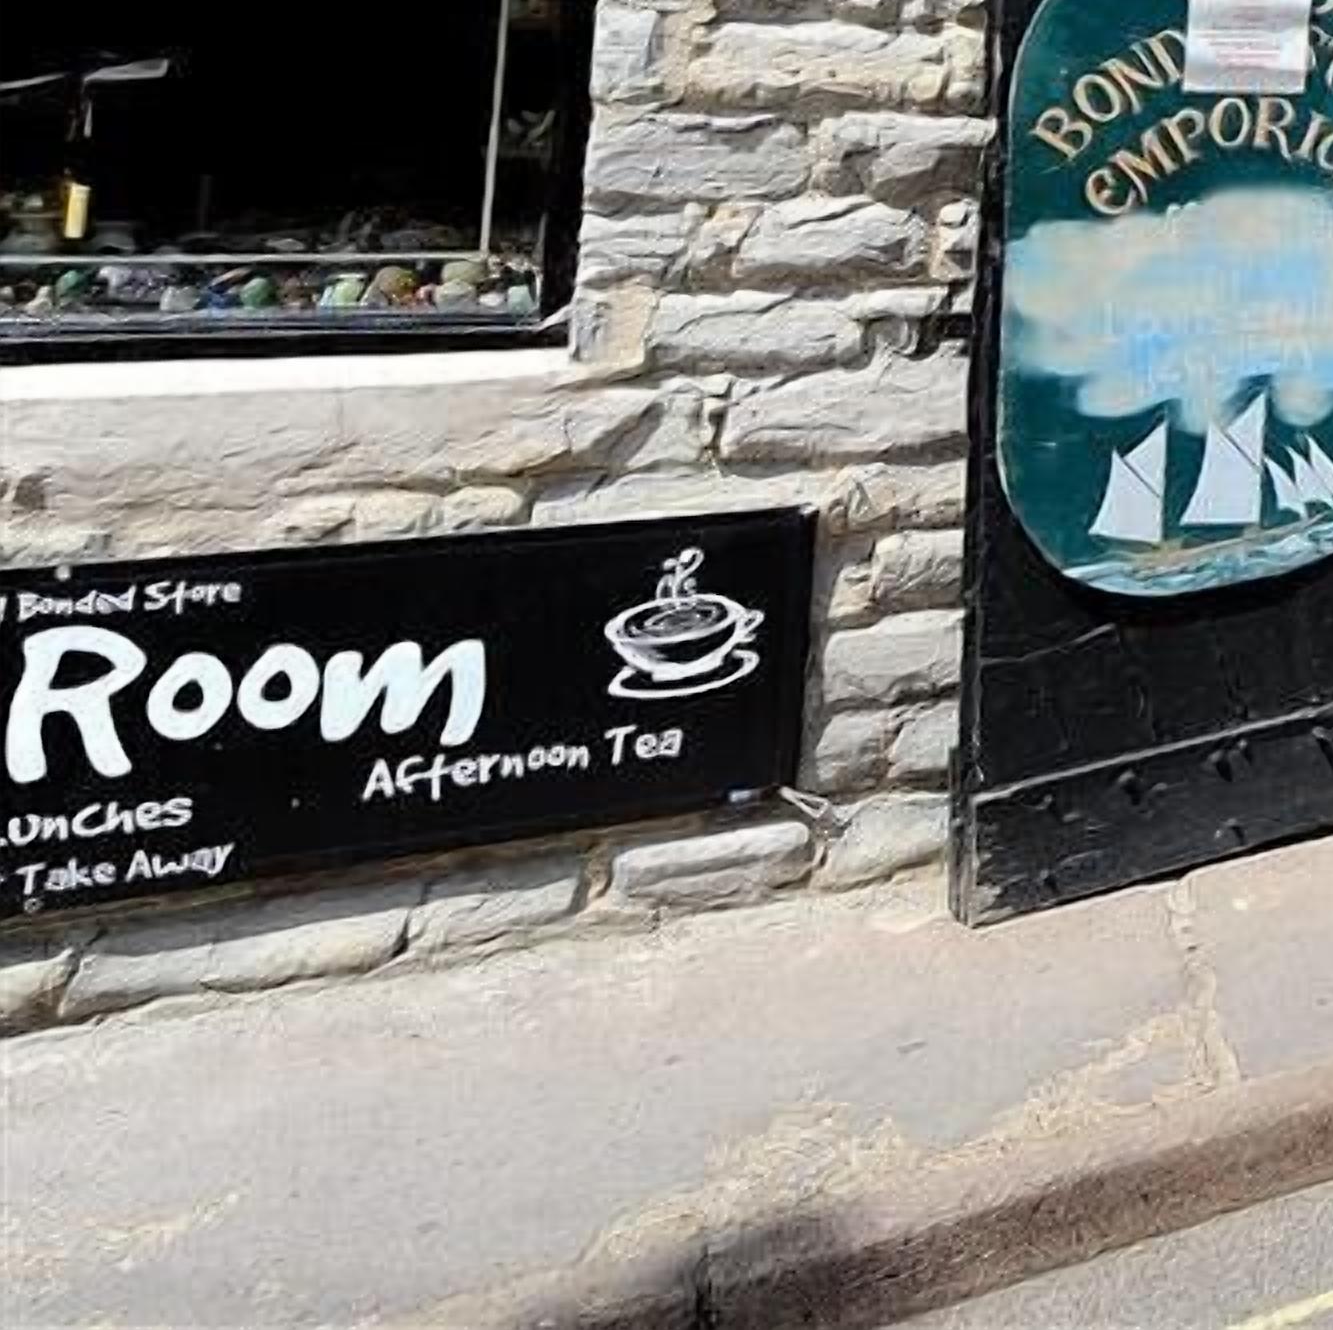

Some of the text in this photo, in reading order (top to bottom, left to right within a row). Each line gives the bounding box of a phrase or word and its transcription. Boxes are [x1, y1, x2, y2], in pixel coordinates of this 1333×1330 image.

[1029, 29, 1186, 161] BOND
[17, 584, 137, 622] Bonded
[143, 580, 242, 614] Store
[5, 624, 487, 785] Room
[362, 724, 684, 802] Afternoon Tea
[0, 797, 193, 847] unches
[15, 841, 236, 895] Take Away
